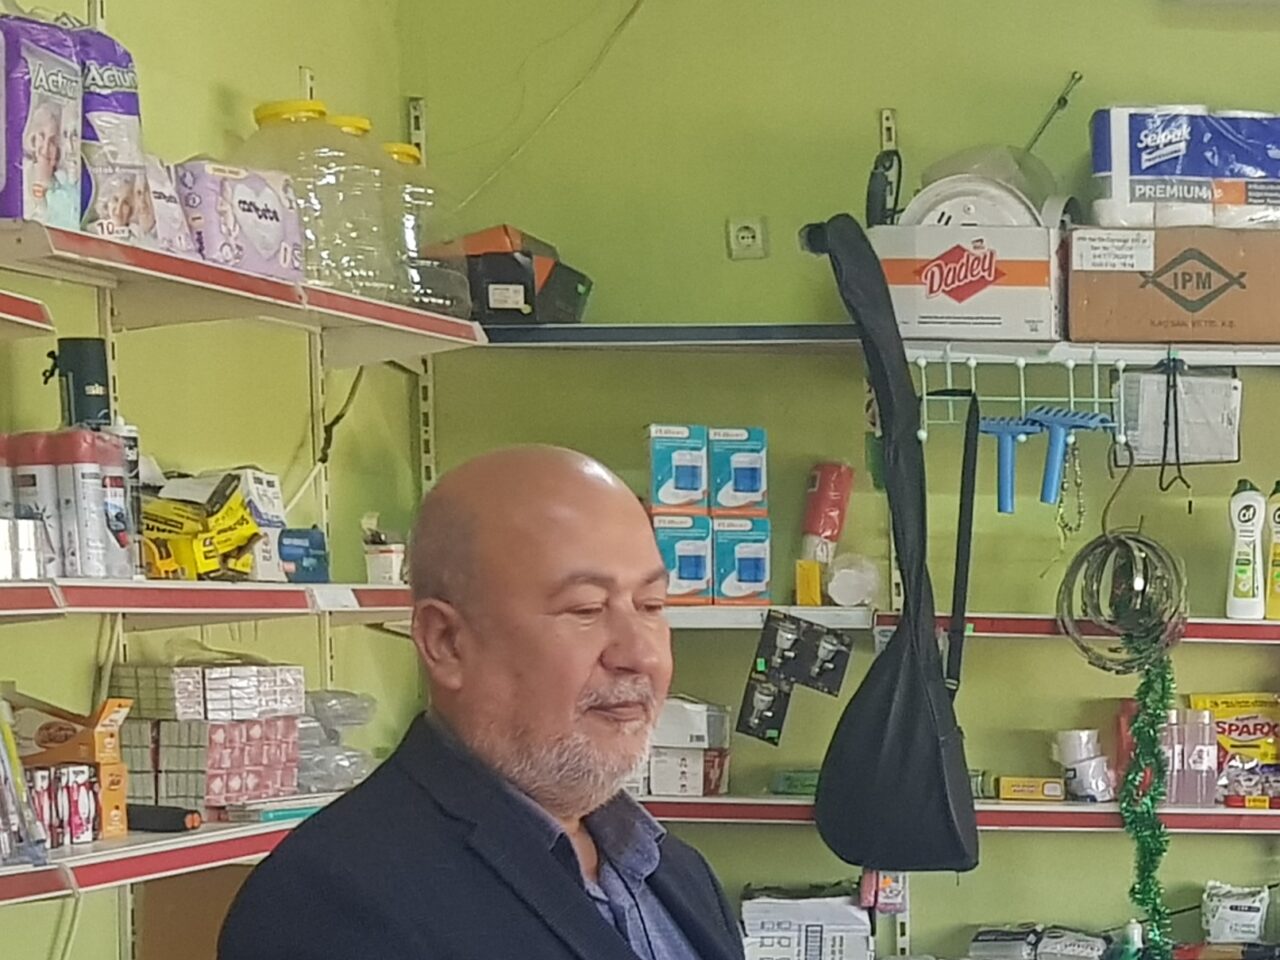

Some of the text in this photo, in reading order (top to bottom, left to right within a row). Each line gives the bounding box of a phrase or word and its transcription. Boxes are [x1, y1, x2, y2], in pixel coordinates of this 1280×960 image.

[1136, 124, 1191, 148] Selpak
[1135, 184, 1206, 198] PREMIUM
[1173, 272, 1212, 289] IPM
[1216, 721, 1280, 737] SPARX
